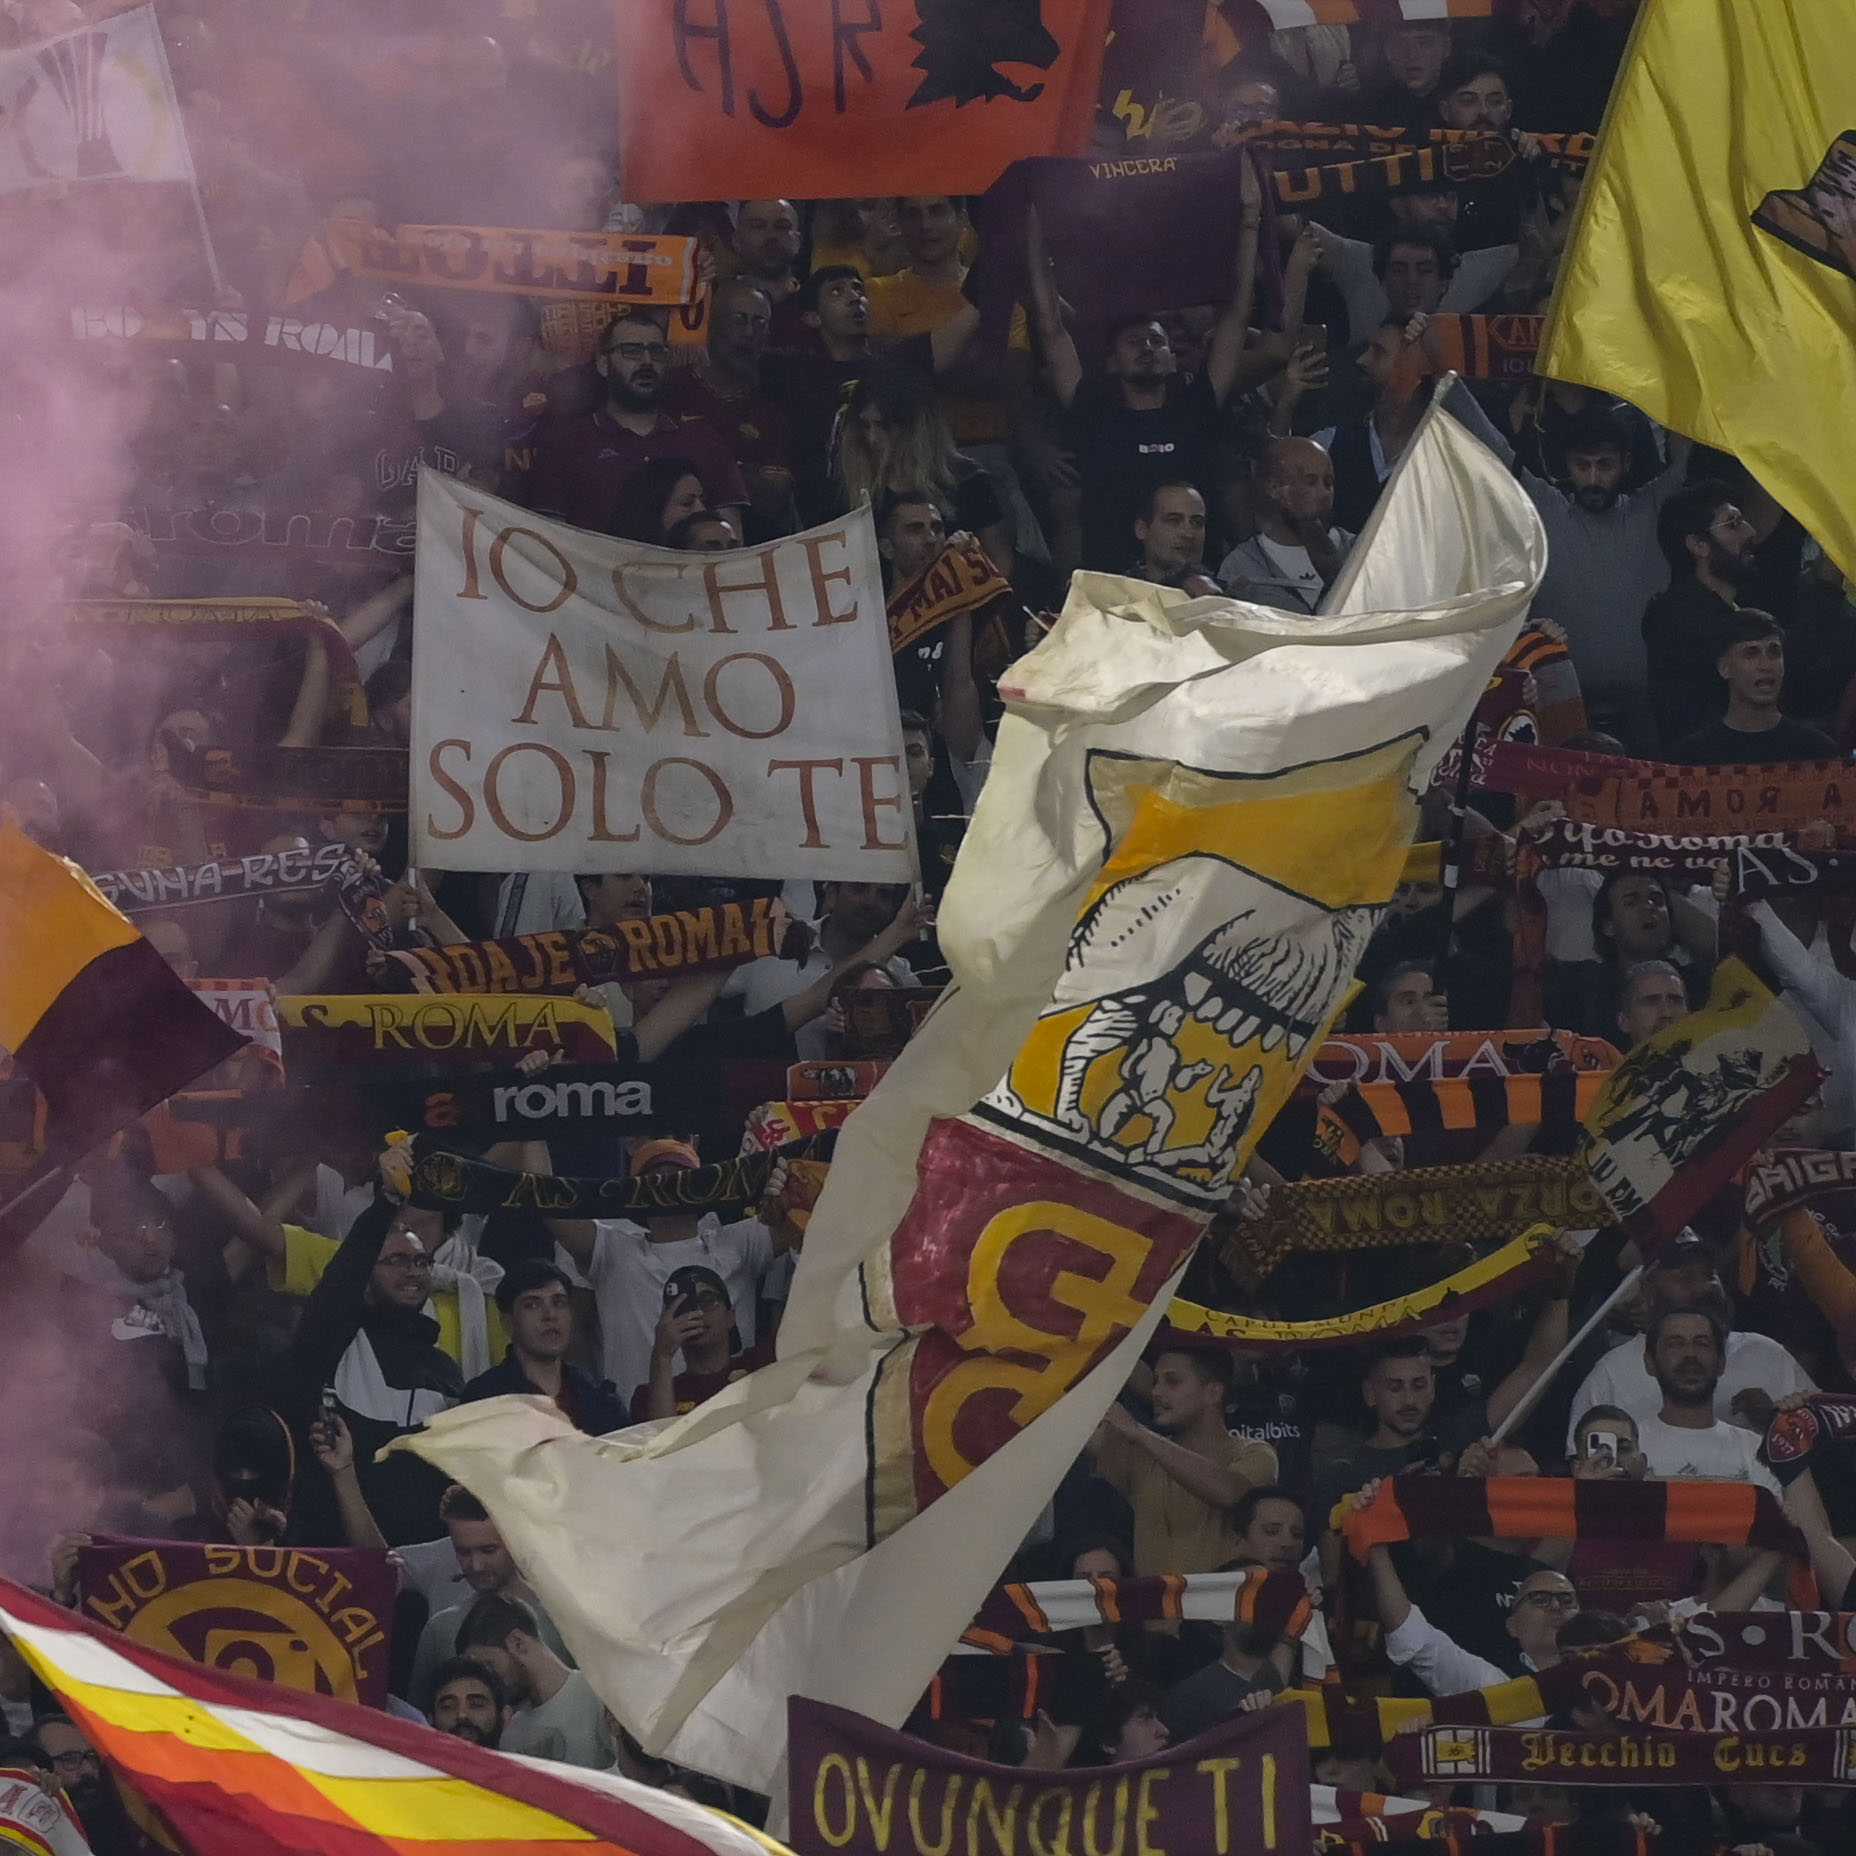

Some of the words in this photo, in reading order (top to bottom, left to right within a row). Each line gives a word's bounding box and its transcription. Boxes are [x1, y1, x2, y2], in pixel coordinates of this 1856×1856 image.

[457, 507, 579, 614] IO
[612, 530, 859, 634] CHE
[511, 631, 796, 739] AMO
[427, 739, 735, 849] SOLO
[767, 754, 906, 851] TE
[1735, 846, 1821, 895] AS
[450, 931, 575, 995] DAJE
[620, 907, 755, 975] ROMA
[370, 1001, 565, 1051] ROMA
[493, 1078, 655, 1123] roma
[204, 1545, 385, 1680] SOCIAL
[1520, 1732, 1678, 1773] Vecchio
[1714, 1735, 1808, 1769] Cucs
[813, 1751, 1161, 1856] OVUNQUE
[1194, 1752, 1277, 1852] TI
